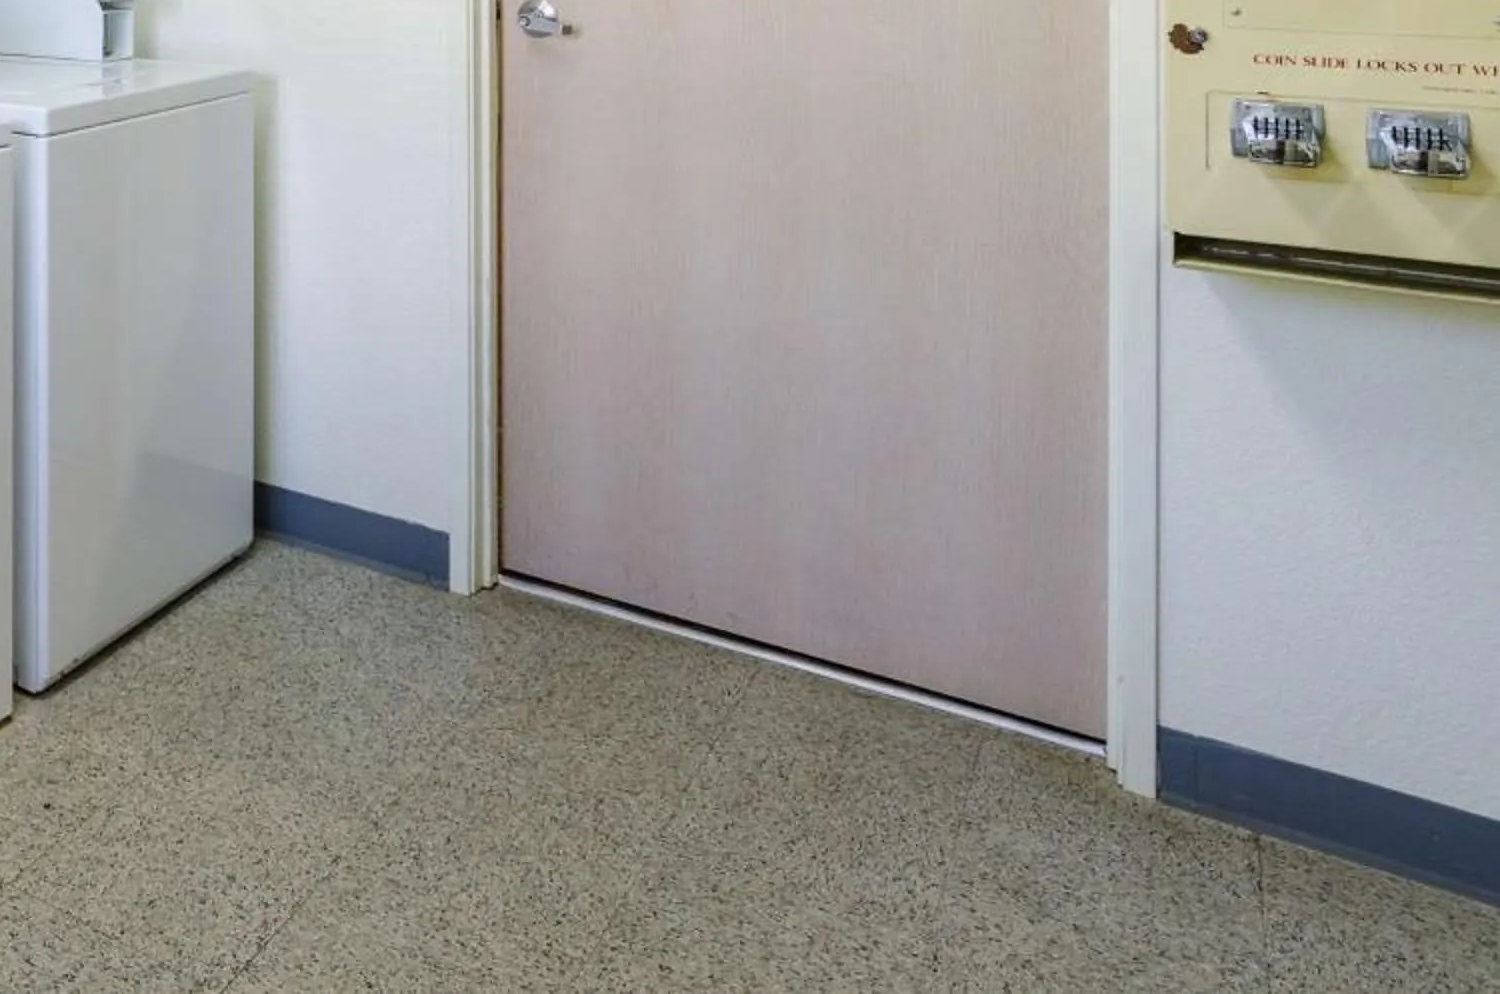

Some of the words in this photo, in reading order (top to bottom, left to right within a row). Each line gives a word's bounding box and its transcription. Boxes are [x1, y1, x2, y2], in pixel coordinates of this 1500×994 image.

[1252, 53, 1297, 66] COIN
[1303, 56, 1349, 70] SLIDE
[1356, 59, 1419, 74] LOCKS
[1423, 62, 1467, 76] OUT
